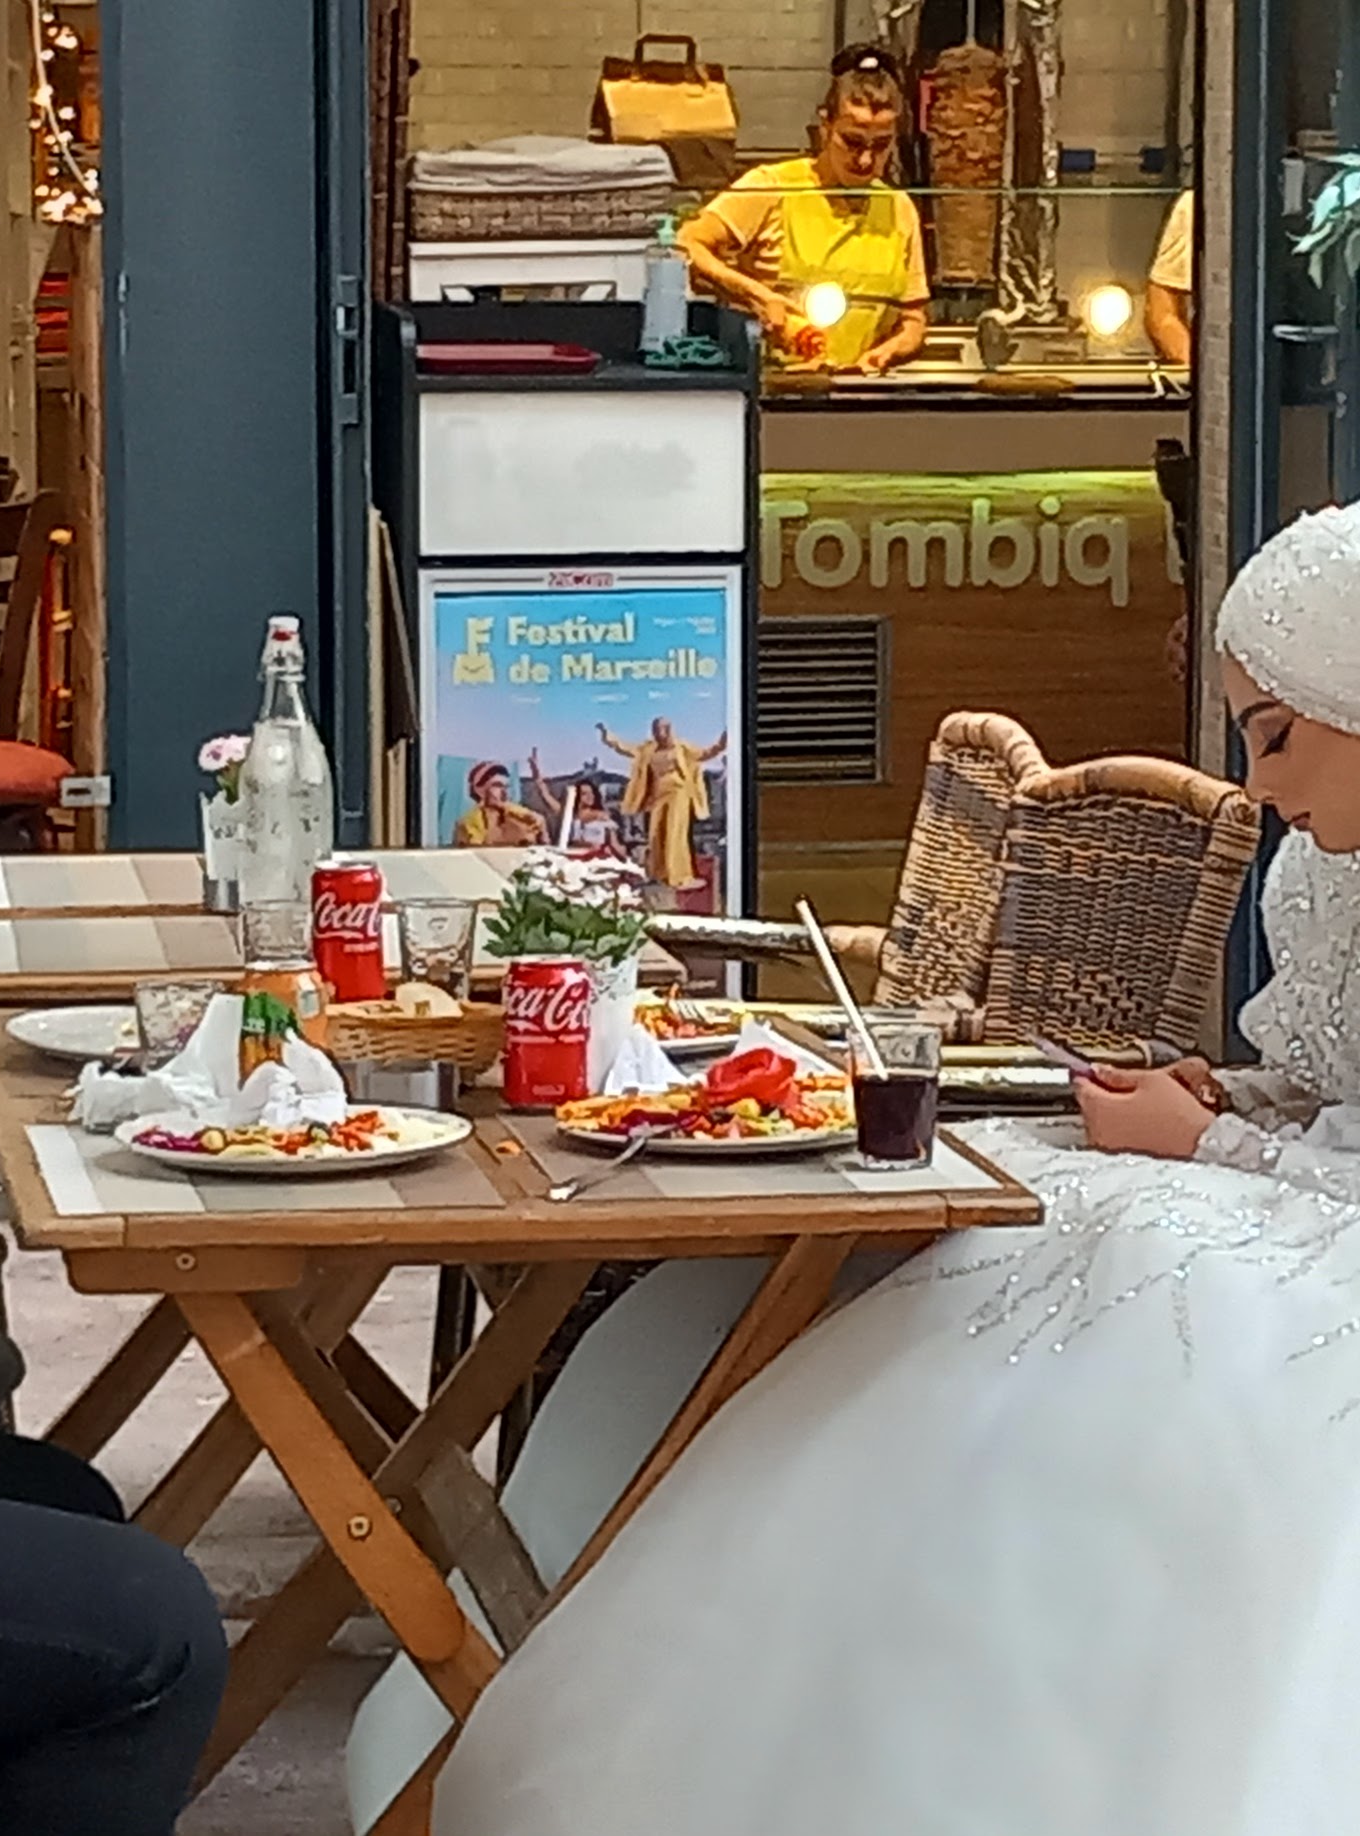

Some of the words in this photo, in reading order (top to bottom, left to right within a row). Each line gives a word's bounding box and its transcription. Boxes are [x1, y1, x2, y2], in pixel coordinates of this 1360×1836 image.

[760, 496, 1129, 606] Tombiq
[507, 611, 635, 646] Festival
[509, 653, 551, 684] de
[561, 648, 718, 683] Marseille
